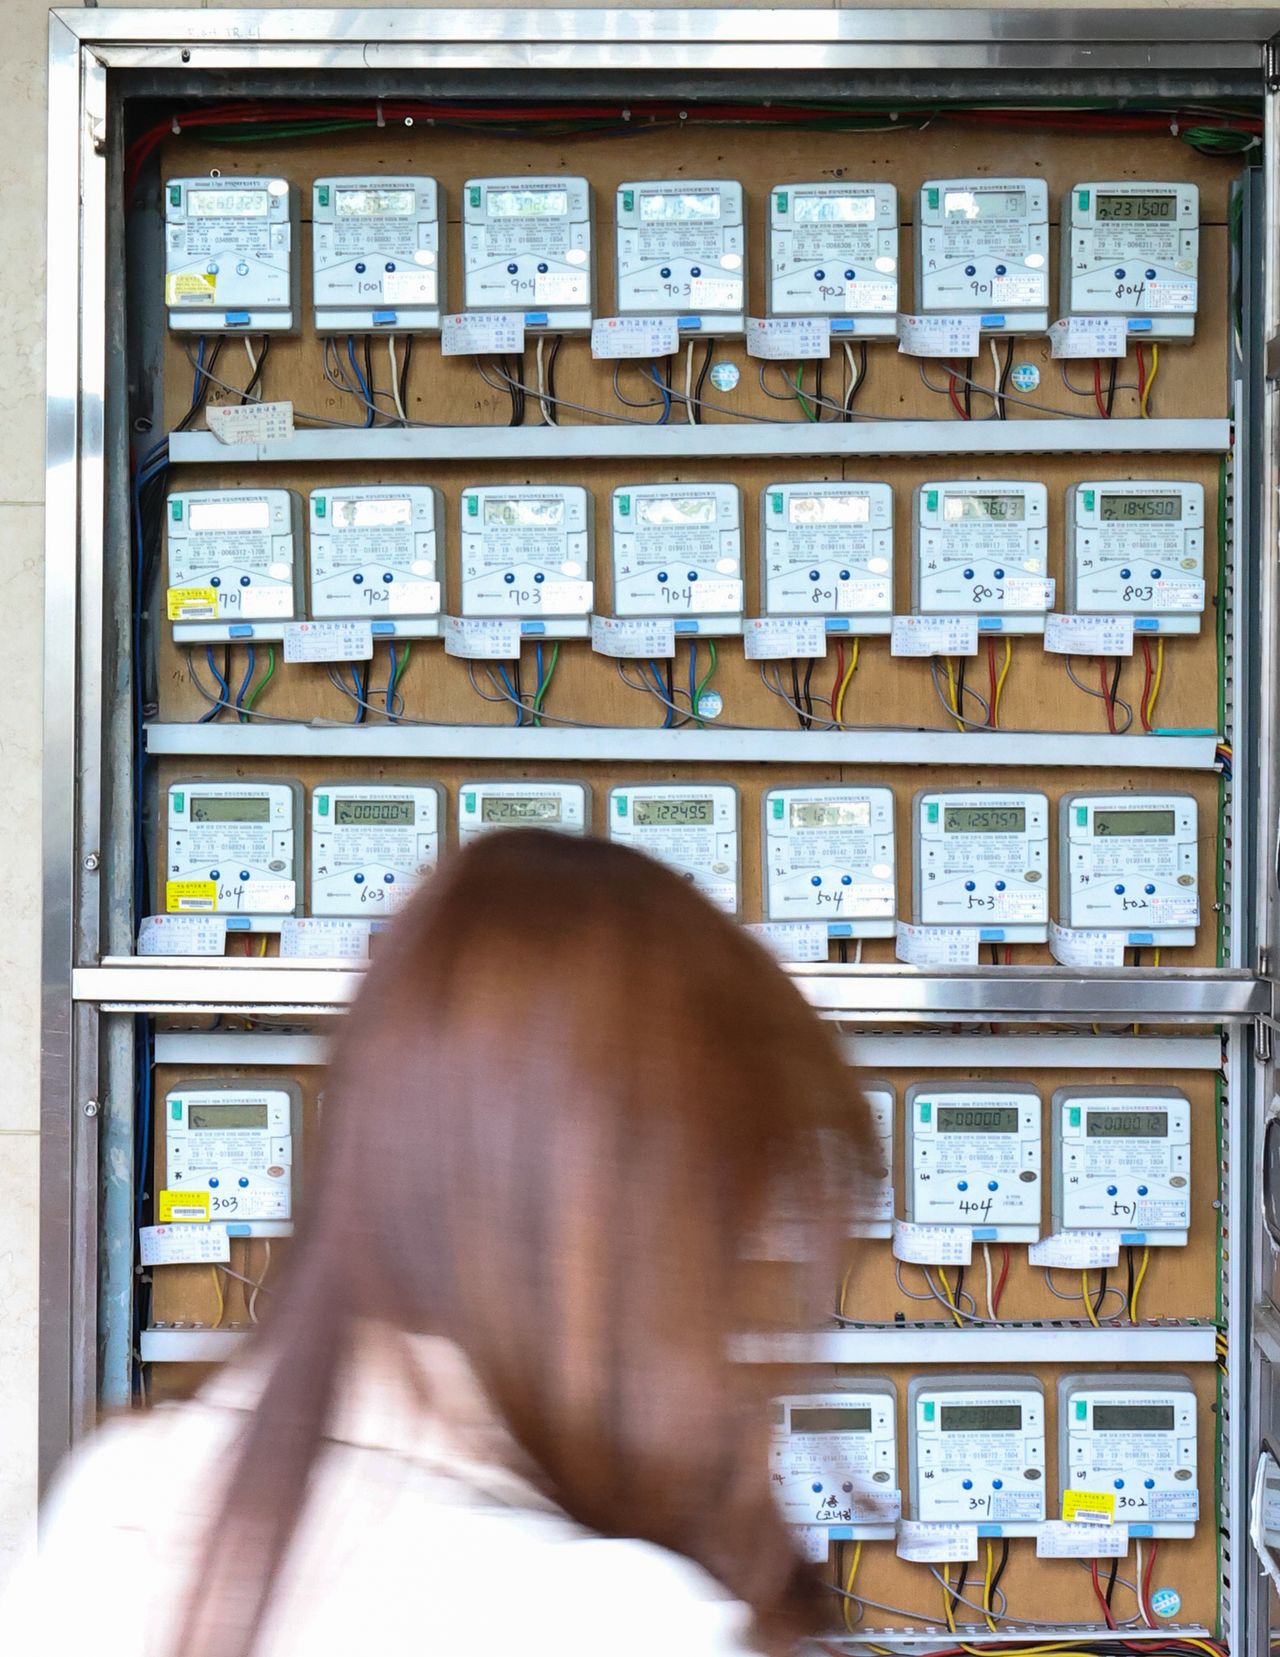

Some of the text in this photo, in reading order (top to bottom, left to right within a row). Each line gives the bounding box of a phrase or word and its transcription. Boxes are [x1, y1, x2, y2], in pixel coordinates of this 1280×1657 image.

[1113, 202, 1169, 216] 231500
[358, 282, 383, 293] 1001
[510, 279, 536, 293] 904
[663, 283, 692, 296] 903
[819, 285, 846, 301] 902
[970, 282, 993, 298] 901
[1115, 282, 1146, 306] 804
[1123, 501, 1175, 515] 184500
[218, 589, 242, 609] 701
[363, 589, 389, 605] 702
[509, 589, 542, 605] 703
[661, 587, 692, 607] 704
[812, 587, 839, 611] 801
[972, 585, 1004, 603] 802
[1122, 586, 1153, 602] 803
[218, 885, 245, 909] 604
[360, 885, 385, 903] 603
[816, 890, 843, 911] 504
[967, 895, 995, 910] 503
[1122, 898, 1149, 910] 502
[212, 1196, 239, 1213] 303
[959, 1197, 993, 1223] 404
[1112, 1201, 1137, 1224] 501
[968, 1495, 991, 1516] 301
[1118, 1496, 1148, 1509] 302
